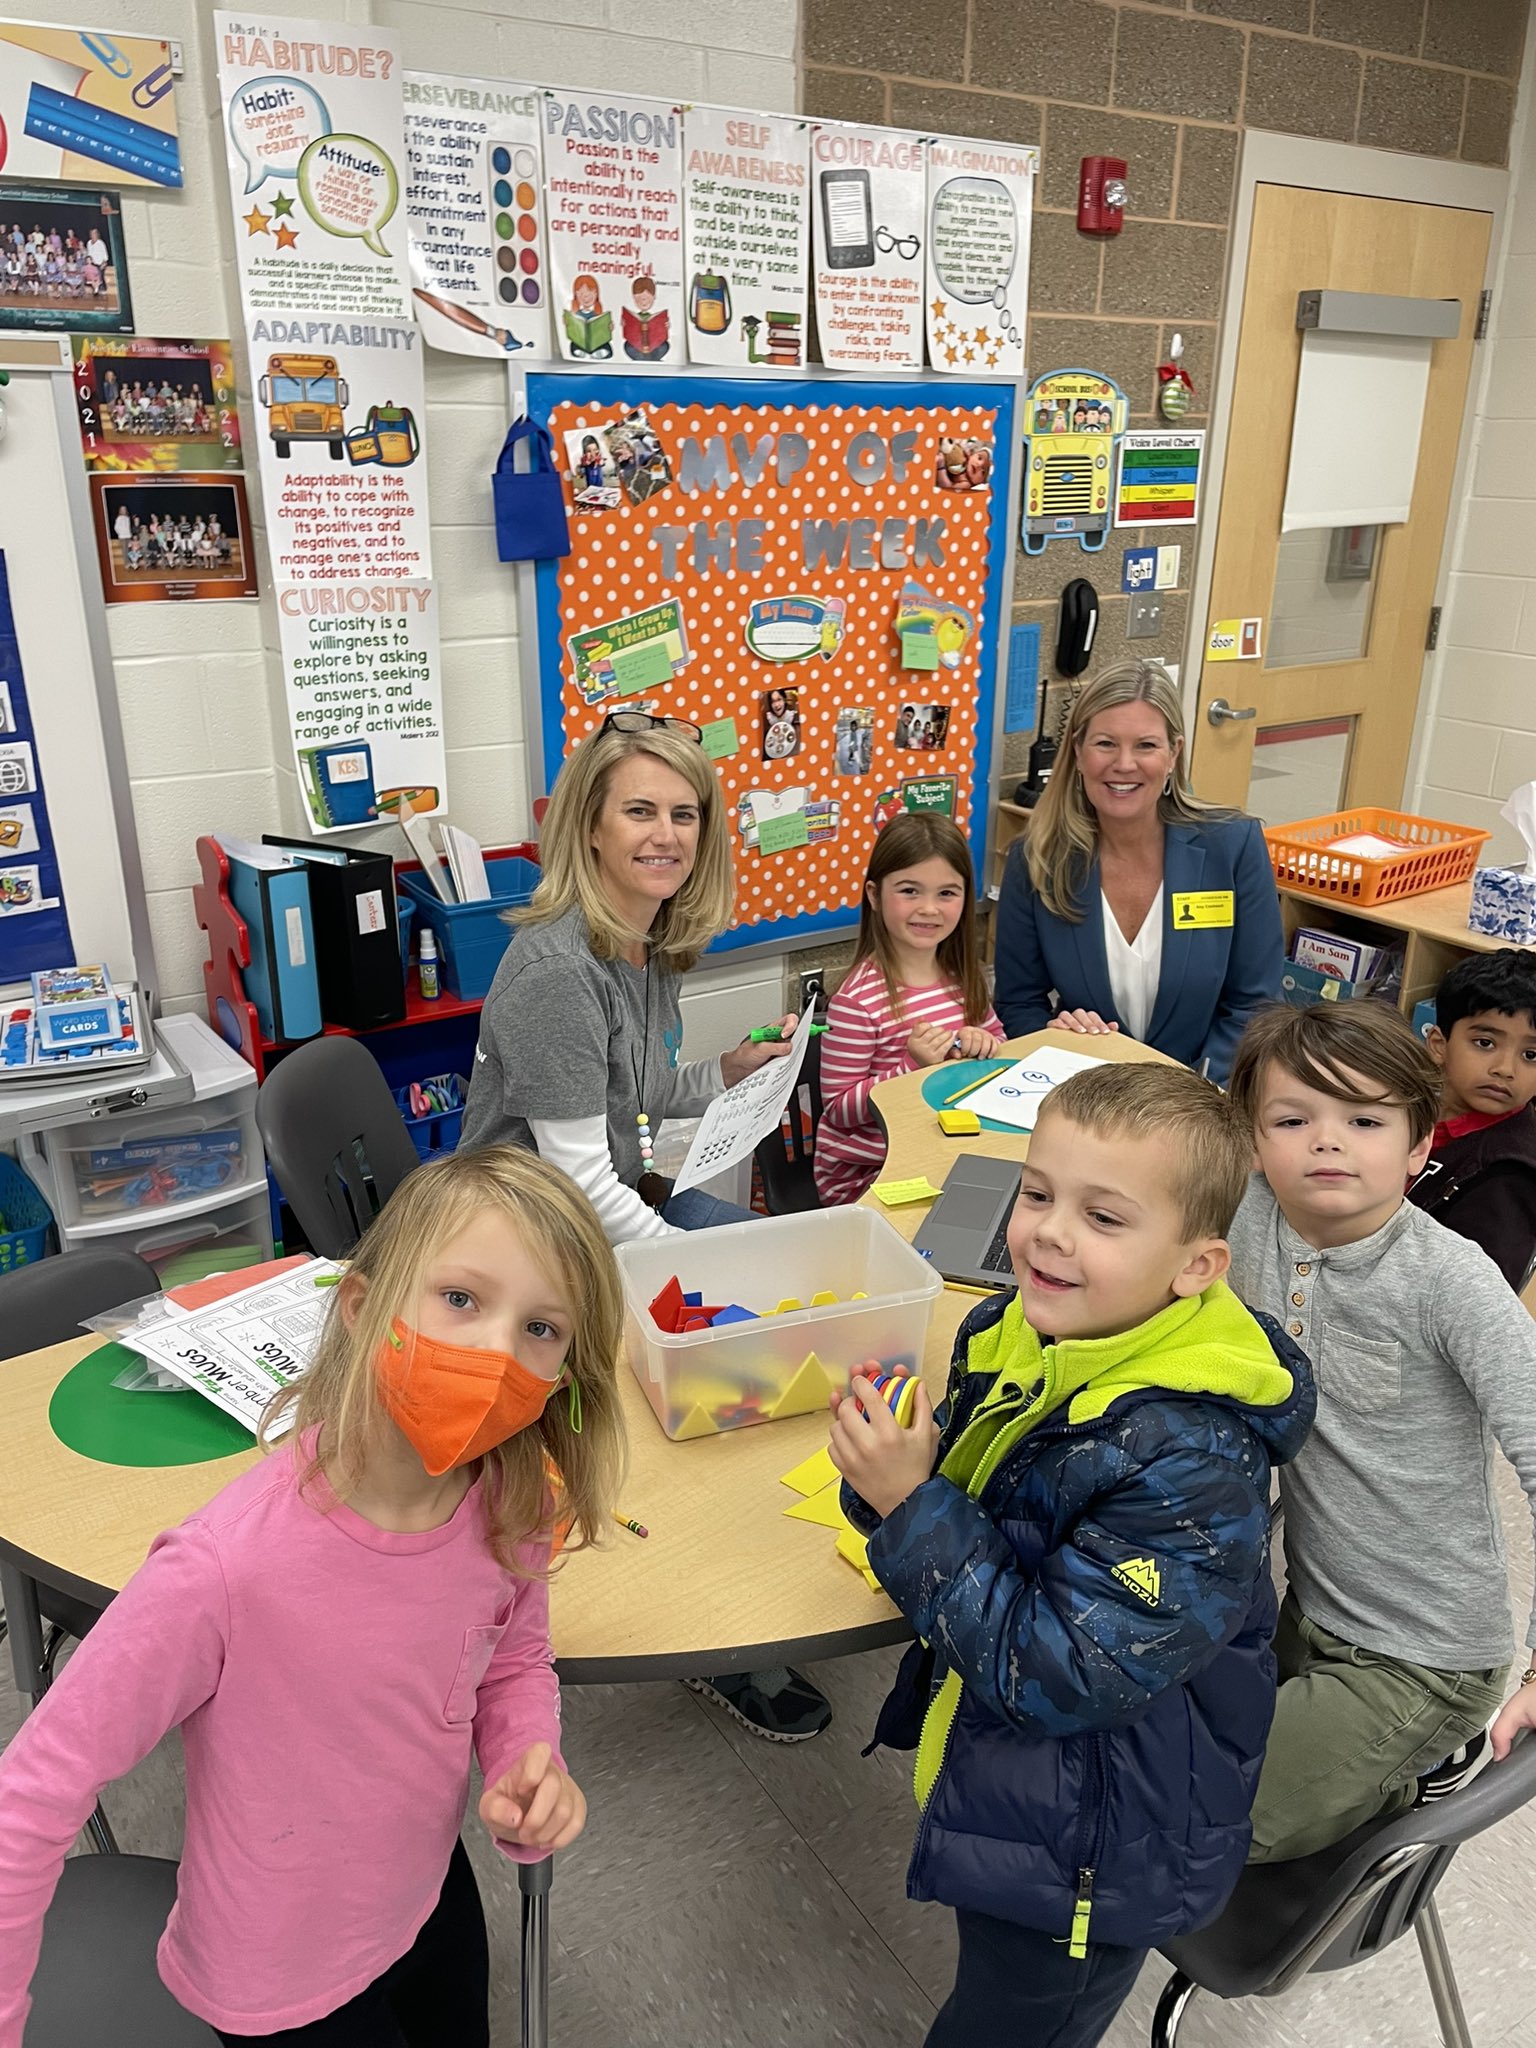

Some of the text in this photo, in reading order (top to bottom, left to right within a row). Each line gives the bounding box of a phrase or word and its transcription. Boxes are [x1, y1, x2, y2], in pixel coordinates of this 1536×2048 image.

[224, 35, 394, 80] HABITUDE?
[242, 88, 295, 114] Habit:
[547, 101, 675, 148] PASSION
[726, 120, 770, 150] SELF
[440, 134, 481, 154] ability
[566, 139, 659, 164] Passion is the
[815, 135, 922, 171] COURAGE
[319, 144, 385, 176] Attitude:
[408, 148, 474, 168] to sustain
[688, 150, 805, 187] AWARENESS
[930, 148, 1030, 176] IMAGINATION
[413, 168, 470, 187] interest,
[584, 161, 644, 182] ability to
[406, 185, 482, 204] effort, and
[550, 178, 677, 203] intentionally reach
[692, 178, 800, 205] Self-awareness is
[561, 198, 668, 222] for actions that
[690, 198, 767, 220] the ability to
[426, 222, 438, 235] in
[551, 218, 679, 241] are personally and
[694, 216, 798, 240] and be inside and
[592, 240, 641, 259] socially
[693, 234, 798, 257] outside ourselves
[454, 259, 475, 273] life
[578, 259, 655, 278] meaningful.
[693, 251, 799, 274] at the very same
[732, 273, 762, 287] time.
[252, 319, 416, 350] ADAPTABILITY
[1130, 438, 1196, 448] Voice Level Chart
[678, 430, 920, 494] MVP OF
[284, 474, 404, 489] Adaptability is the
[282, 490, 409, 504] ability to cope with
[277, 506, 414, 520] change, to recognize
[294, 521, 400, 535] its positives and
[292, 536, 405, 551] negatives, and to
[651, 516, 948, 580] THE WEEK
[280, 550, 420, 566] manage one's actions
[291, 566, 413, 579] to address change.
[280, 586, 431, 616] CURIOSITY
[760, 601, 814, 621] My Name
[309, 617, 407, 632] Curiosity is a
[607, 607, 675, 639] When I Grow Up,
[309, 633, 409, 651] willingness to
[618, 621, 668, 647] I Want to Be
[1211, 633, 1234, 648] door
[293, 650, 427, 670] explore by asking
[293, 666, 430, 689] questions, seeking
[314, 683, 412, 703] answers, and
[296, 699, 433, 722] engaging in a wide
[295, 716, 437, 740] range of activities.
[336, 758, 359, 775] KES
[907, 782, 951, 795] My Favorite
[913, 793, 945, 806] Subject
[1303, 940, 1306, 948] I
[1308, 942, 1325, 953] Am
[1328, 949, 1350, 961] Sam
[52, 1014, 105, 1026] WORD STUDY
[62, 1022, 98, 1033] CARDS
[177, 1349, 233, 1381] MUGS
[253, 1342, 304, 1375] MUGS
[1110, 1567, 1158, 1607] SNOZU
